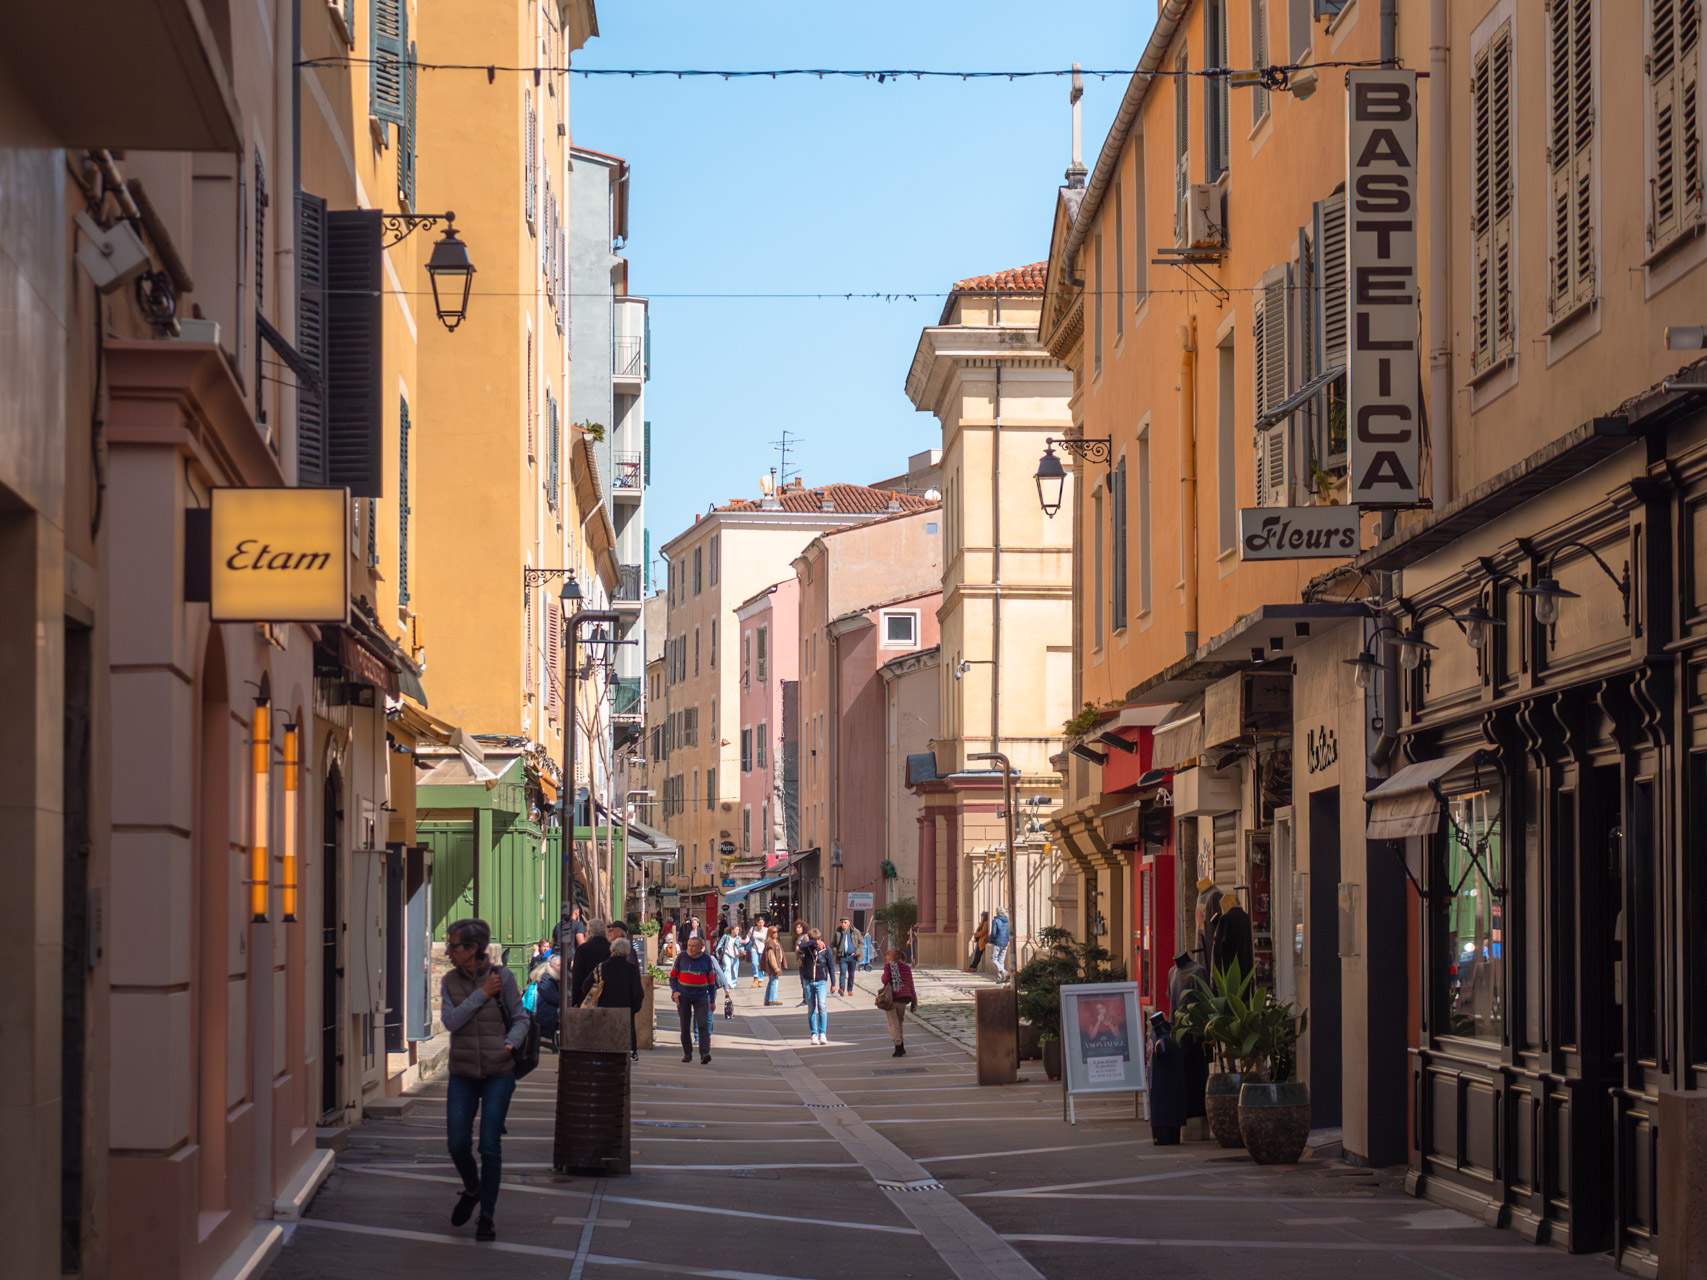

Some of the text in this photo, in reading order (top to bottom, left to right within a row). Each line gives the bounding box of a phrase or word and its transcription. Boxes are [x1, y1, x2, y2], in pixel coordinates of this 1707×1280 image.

[1355, 82, 1413, 490] BASTELICA
[1245, 515, 1355, 551] Fleurs
[226, 539, 331, 570] Etam
